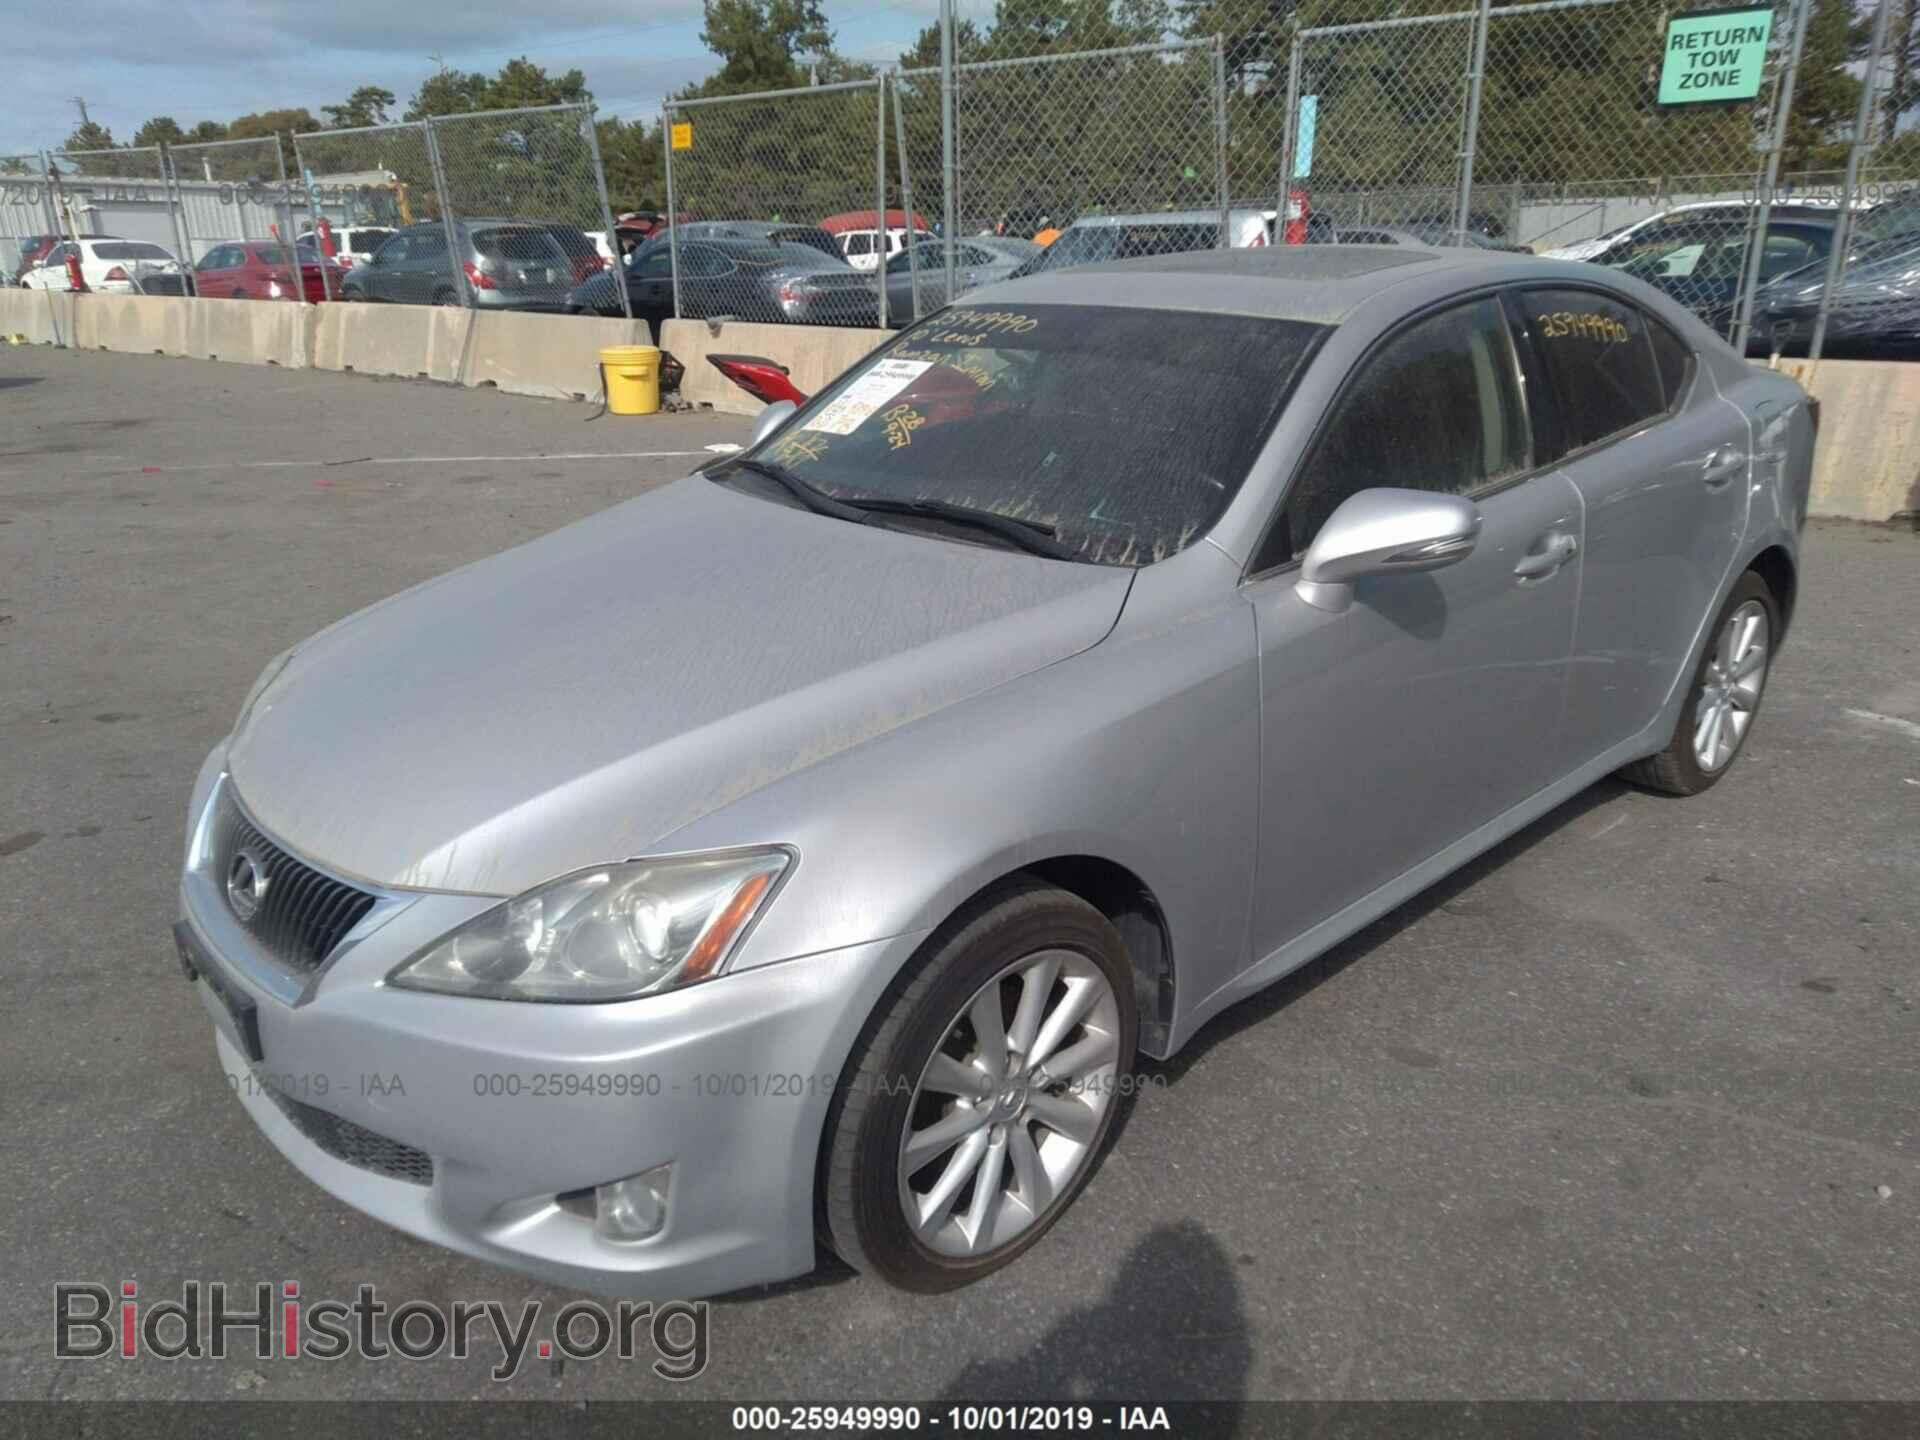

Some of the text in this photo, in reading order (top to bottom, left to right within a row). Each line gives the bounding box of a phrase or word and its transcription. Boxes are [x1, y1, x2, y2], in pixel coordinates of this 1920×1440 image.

[1670, 25, 1765, 51] RETURN
[1688, 49, 1740, 69] TOW
[1678, 69, 1741, 90] ZONE
